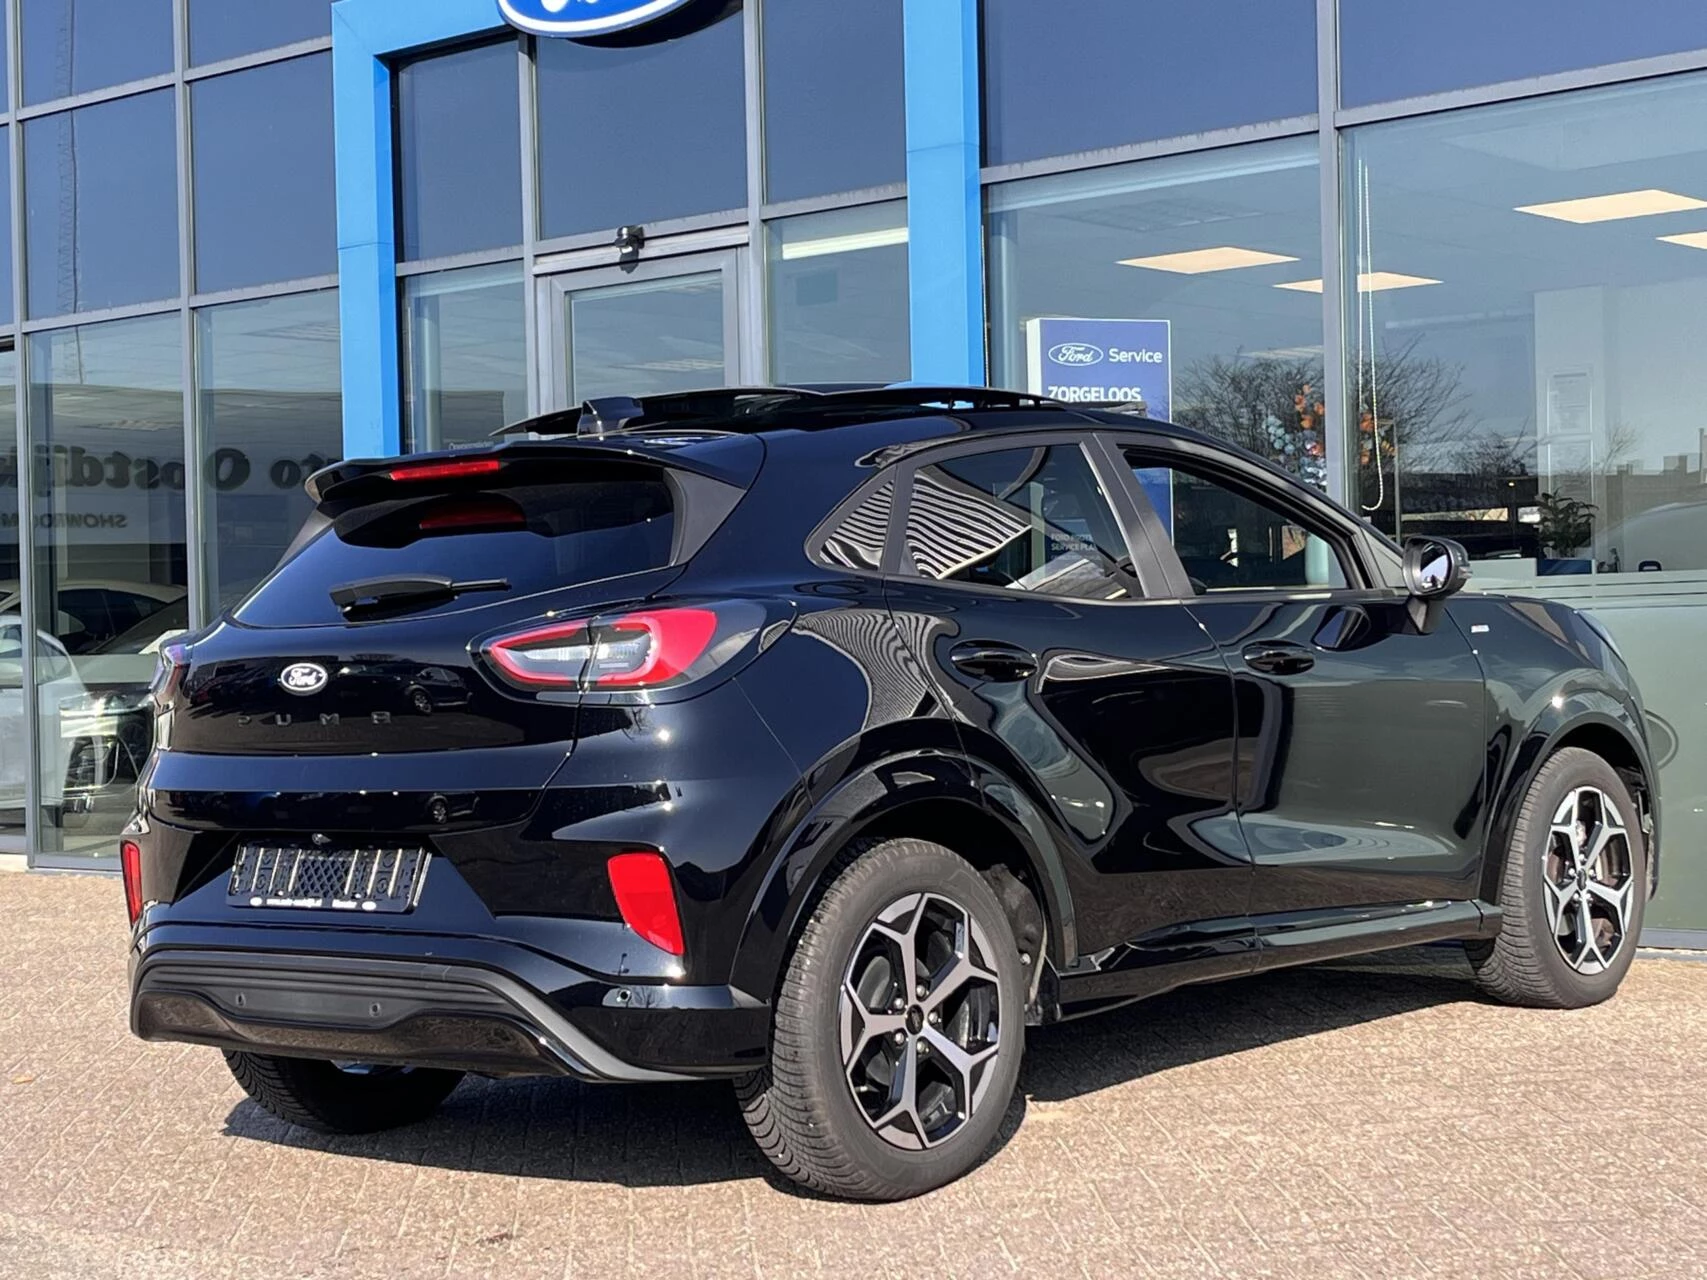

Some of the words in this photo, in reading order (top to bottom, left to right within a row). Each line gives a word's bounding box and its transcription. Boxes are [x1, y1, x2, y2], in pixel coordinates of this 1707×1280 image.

[1058, 346, 1094, 362] Ford
[1109, 348, 1163, 363] Service
[1048, 386, 1142, 401] ZORGELOOS
